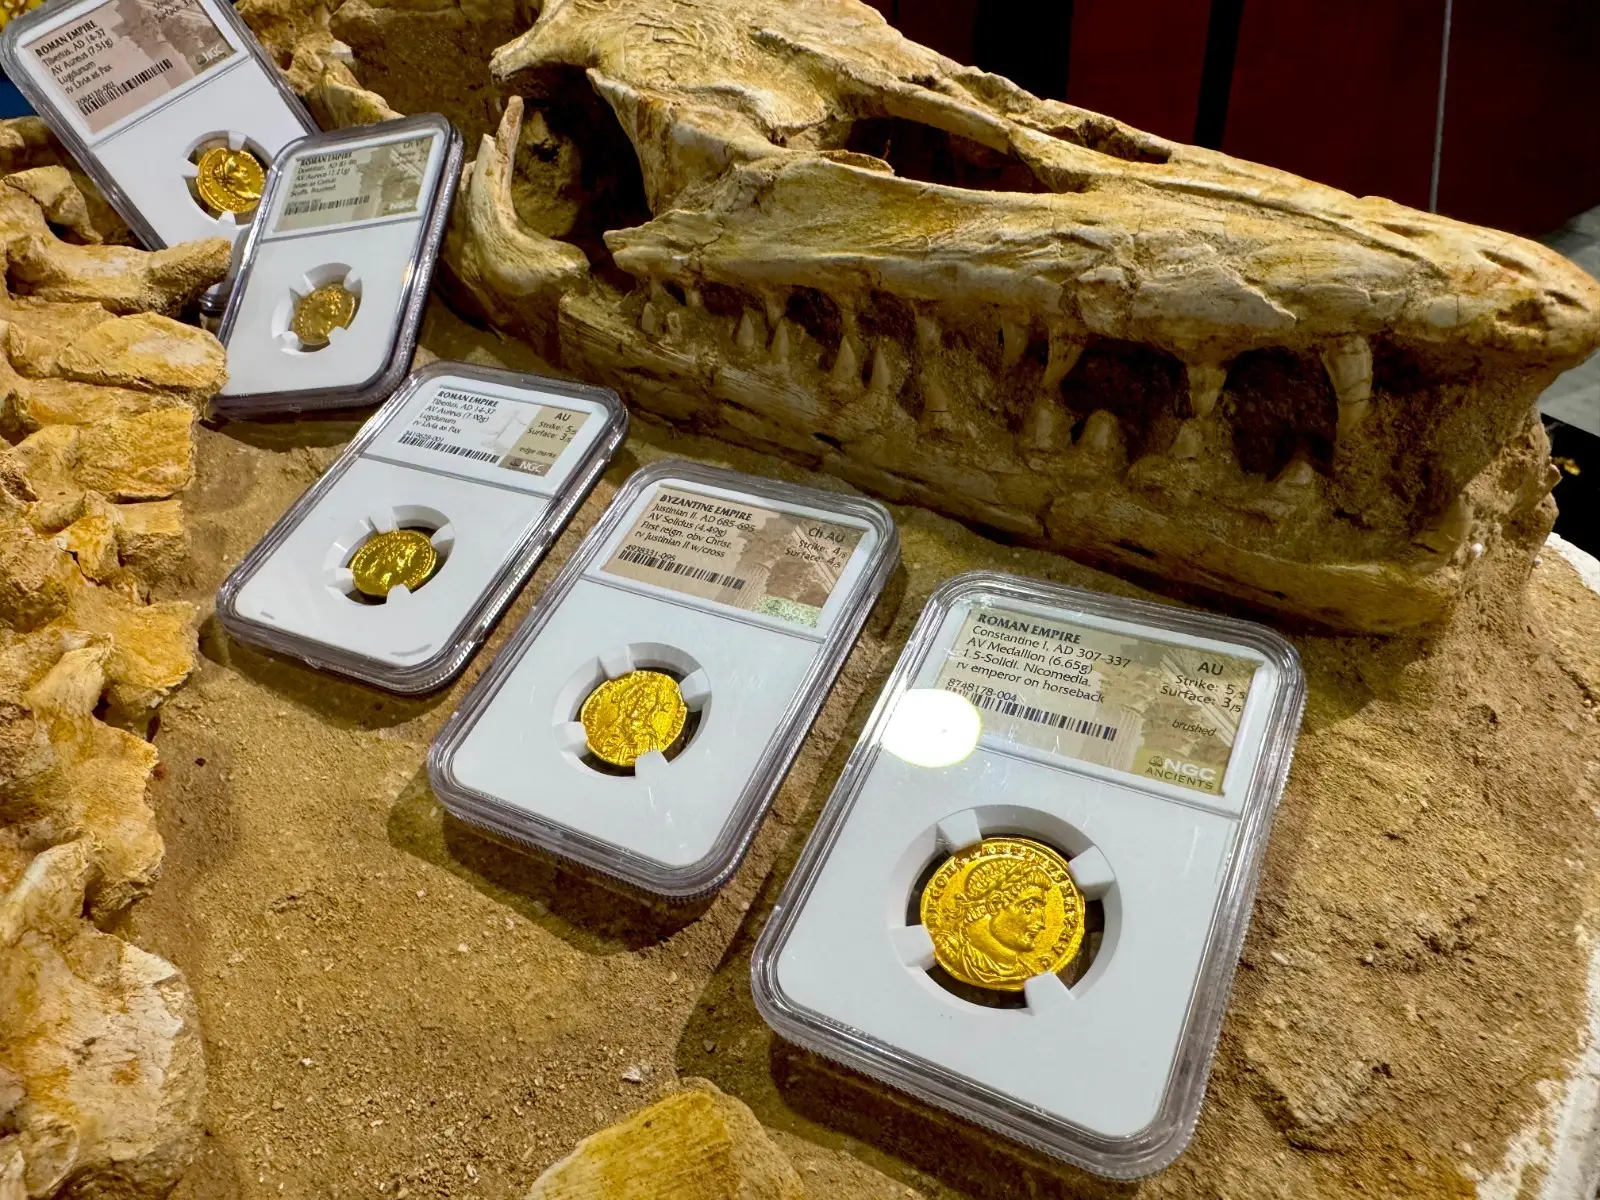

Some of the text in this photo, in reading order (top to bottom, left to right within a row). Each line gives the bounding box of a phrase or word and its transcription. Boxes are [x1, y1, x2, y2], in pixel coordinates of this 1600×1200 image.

[35, 20, 98, 57] ROMAN EMPIRE
[72, 39, 85, 51] AD
[85, 28, 106, 44] 14-37
[51, 64, 63, 76] AV
[63, 54, 89, 69] Aureus
[57, 61, 96, 85] Lugdunum
[90, 71, 100, 80] as
[98, 63, 113, 75] Pax
[301, 152, 352, 167] ROMAN EMPIRE
[437, 390, 499, 408] ROMAN EMPIRE
[460, 401, 473, 410] AD
[474, 405, 497, 415] 14-37
[419, 411, 457, 425] Lugdunum
[438, 407, 461, 418] Aureus
[554, 412, 572, 422] AU
[448, 425, 462, 434] Pax
[527, 427, 557, 439] Surface:
[538, 421, 563, 431] Strike:
[519, 446, 557, 459] edge marks
[520, 461, 545, 473] NGC
[652, 503, 689, 518] Justinian
[700, 514, 716, 523] AD
[660, 494, 753, 521] BYZANTINE EMPIRE
[640, 521, 660, 531] First
[687, 532, 705, 541] obv
[647, 512, 728, 538] AV Solidus (4.49g)
[808, 527, 847, 543] Ch AU
[625, 544, 677, 561] 4938331-095
[644, 532, 682, 547] Justinian
[682, 540, 690, 549] II
[691, 544, 726, 558] w/cross
[799, 539, 827, 554] Strike:
[785, 547, 824, 562] Surface:
[976, 613, 1082, 645] ROMAN EMPIRE
[972, 625, 1041, 649] Constantine
[1048, 644, 1074, 656] AD
[1076, 648, 1131, 668] 307-337
[966, 637, 1093, 675] AV Medallion (6.65g)
[962, 648, 1093, 688] 1.5-Solidi. Nicomedia.
[1197, 661, 1224, 676] AU
[946, 678, 1018, 703] 8748178-004
[956, 661, 1106, 704] rv emperor on horseback
[1175, 674, 1219, 692] Strike:
[1160, 684, 1242, 713] Surface: 3/5
[1171, 719, 1218, 737] brushed
[1145, 766, 1214, 790] ANCIENTS
[1163, 758, 1217, 780] NGC
